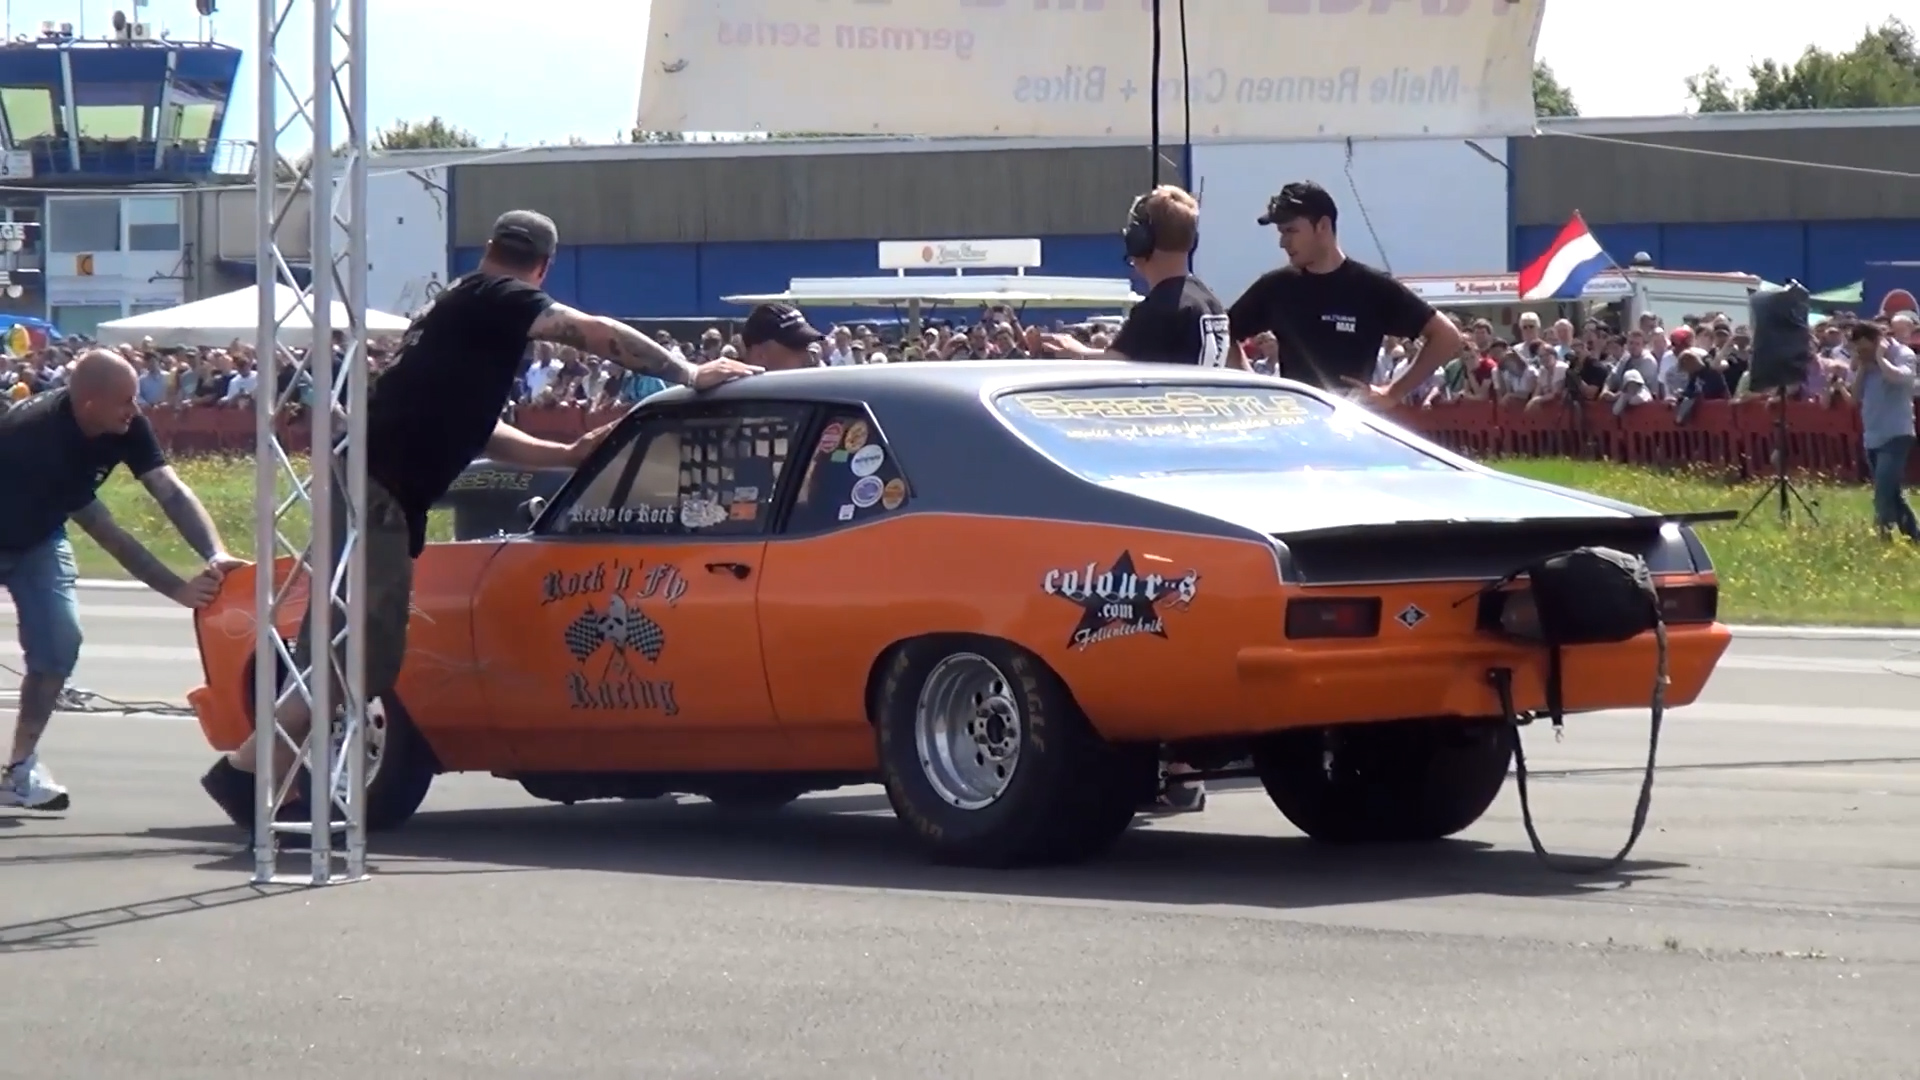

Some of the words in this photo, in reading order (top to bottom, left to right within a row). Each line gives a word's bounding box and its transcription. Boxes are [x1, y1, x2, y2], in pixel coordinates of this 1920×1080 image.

[568, 503, 614, 527] Ready
[618, 505, 632, 523] to
[634, 503, 676, 524] Rock
[541, 562, 606, 606] Rock
[637, 563, 688, 609] Fly
[565, 670, 680, 717] Racing
